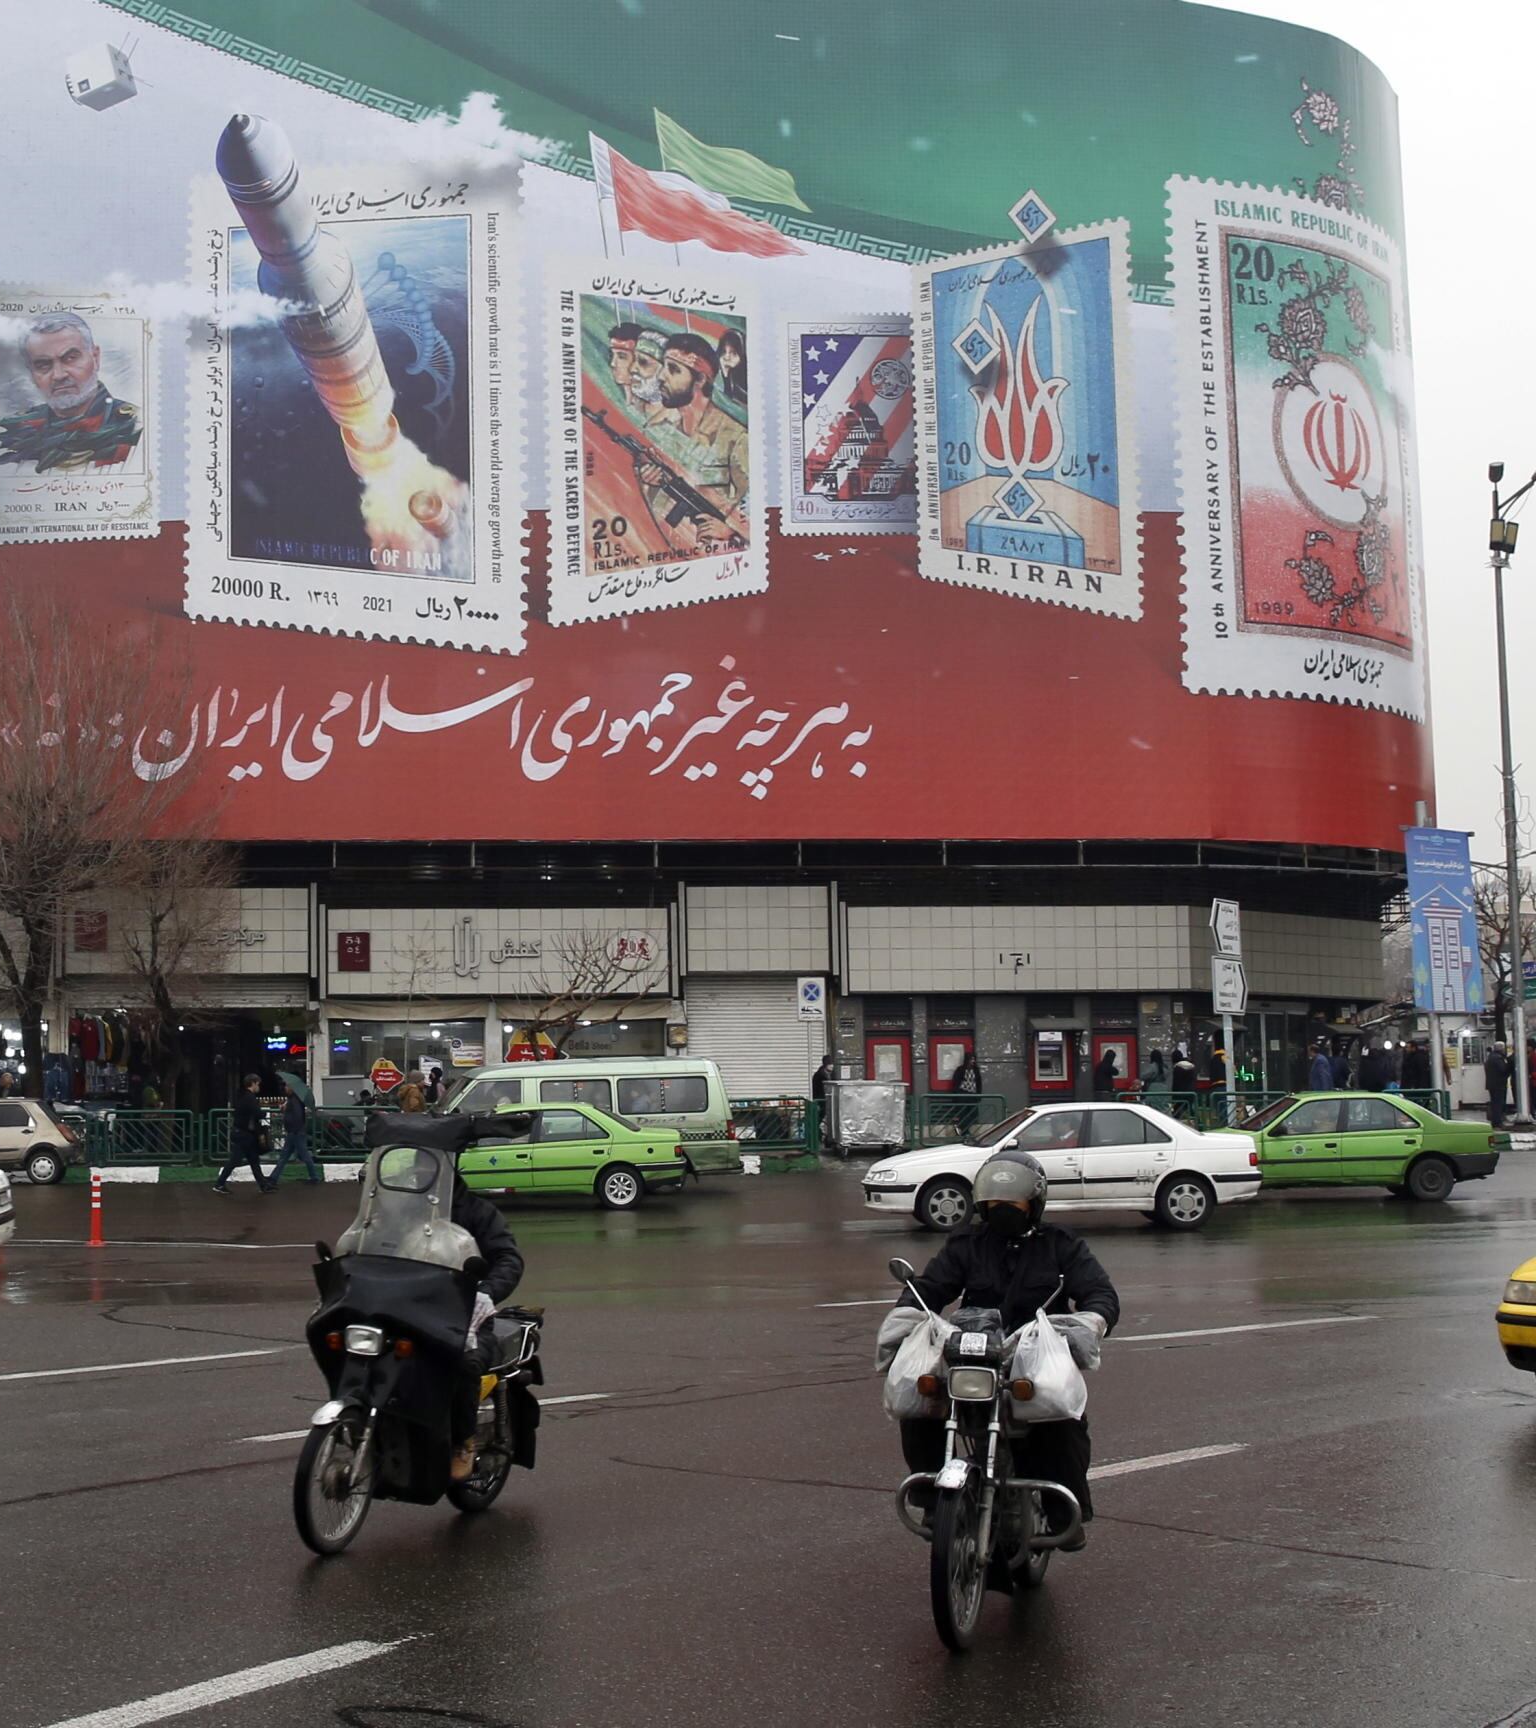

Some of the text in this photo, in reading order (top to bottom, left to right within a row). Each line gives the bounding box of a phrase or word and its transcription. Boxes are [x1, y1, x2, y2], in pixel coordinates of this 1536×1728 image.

[487, 212, 500, 241] Iran's
[1214, 199, 1282, 224] ISLAMIC
[1291, 209, 1354, 242] REPUBLIC
[487, 243, 500, 293] scientific
[1231, 243, 1275, 282] 20
[0, 302, 24, 313] 2020
[486, 296, 500, 335] growth
[488, 337, 500, 358] rate
[489, 360, 500, 369] is
[490, 387, 501, 417] times
[919, 281, 939, 519] ANNIVERSARY OF THE ISLAMIC REPUBLIC OF IRAN
[490, 419, 501, 437] the
[560, 289, 581, 577] THE 8th ANNIVERSARY OF THE SACRED DEFENCE
[1194, 220, 1229, 638] 10th ANNIVERSARY OF THE ESTABLISHMENT
[490, 439, 502, 470] world
[944, 441, 971, 466] 20
[4, 503, 33, 514] 20000
[54, 501, 88, 513] IRAN
[488, 472, 502, 518] average
[86, 523, 100, 532] DAY
[101, 523, 109, 531] OF
[111, 522, 149, 532] RESISTANCE
[488, 520, 504, 560] growth
[592, 516, 628, 541] 20
[383, 549, 400, 567] OF
[407, 549, 442, 572] IRAN
[594, 555, 641, 571] ISLAMIC
[647, 546, 699, 563] REPUBLIC
[705, 544, 719, 553] OF
[492, 562, 502, 584] rate
[1011, 563, 1103, 593] IRAN
[211, 576, 291, 601] 20000 R.
[307, 589, 339, 607] ۱۳۹۹
[363, 596, 393, 613] 2021
[1255, 602, 1294, 616] 1989
[280, 654, 873, 800] به هر چه غیر جمهوری اسلامی
[489, 937, 542, 964] کفش
